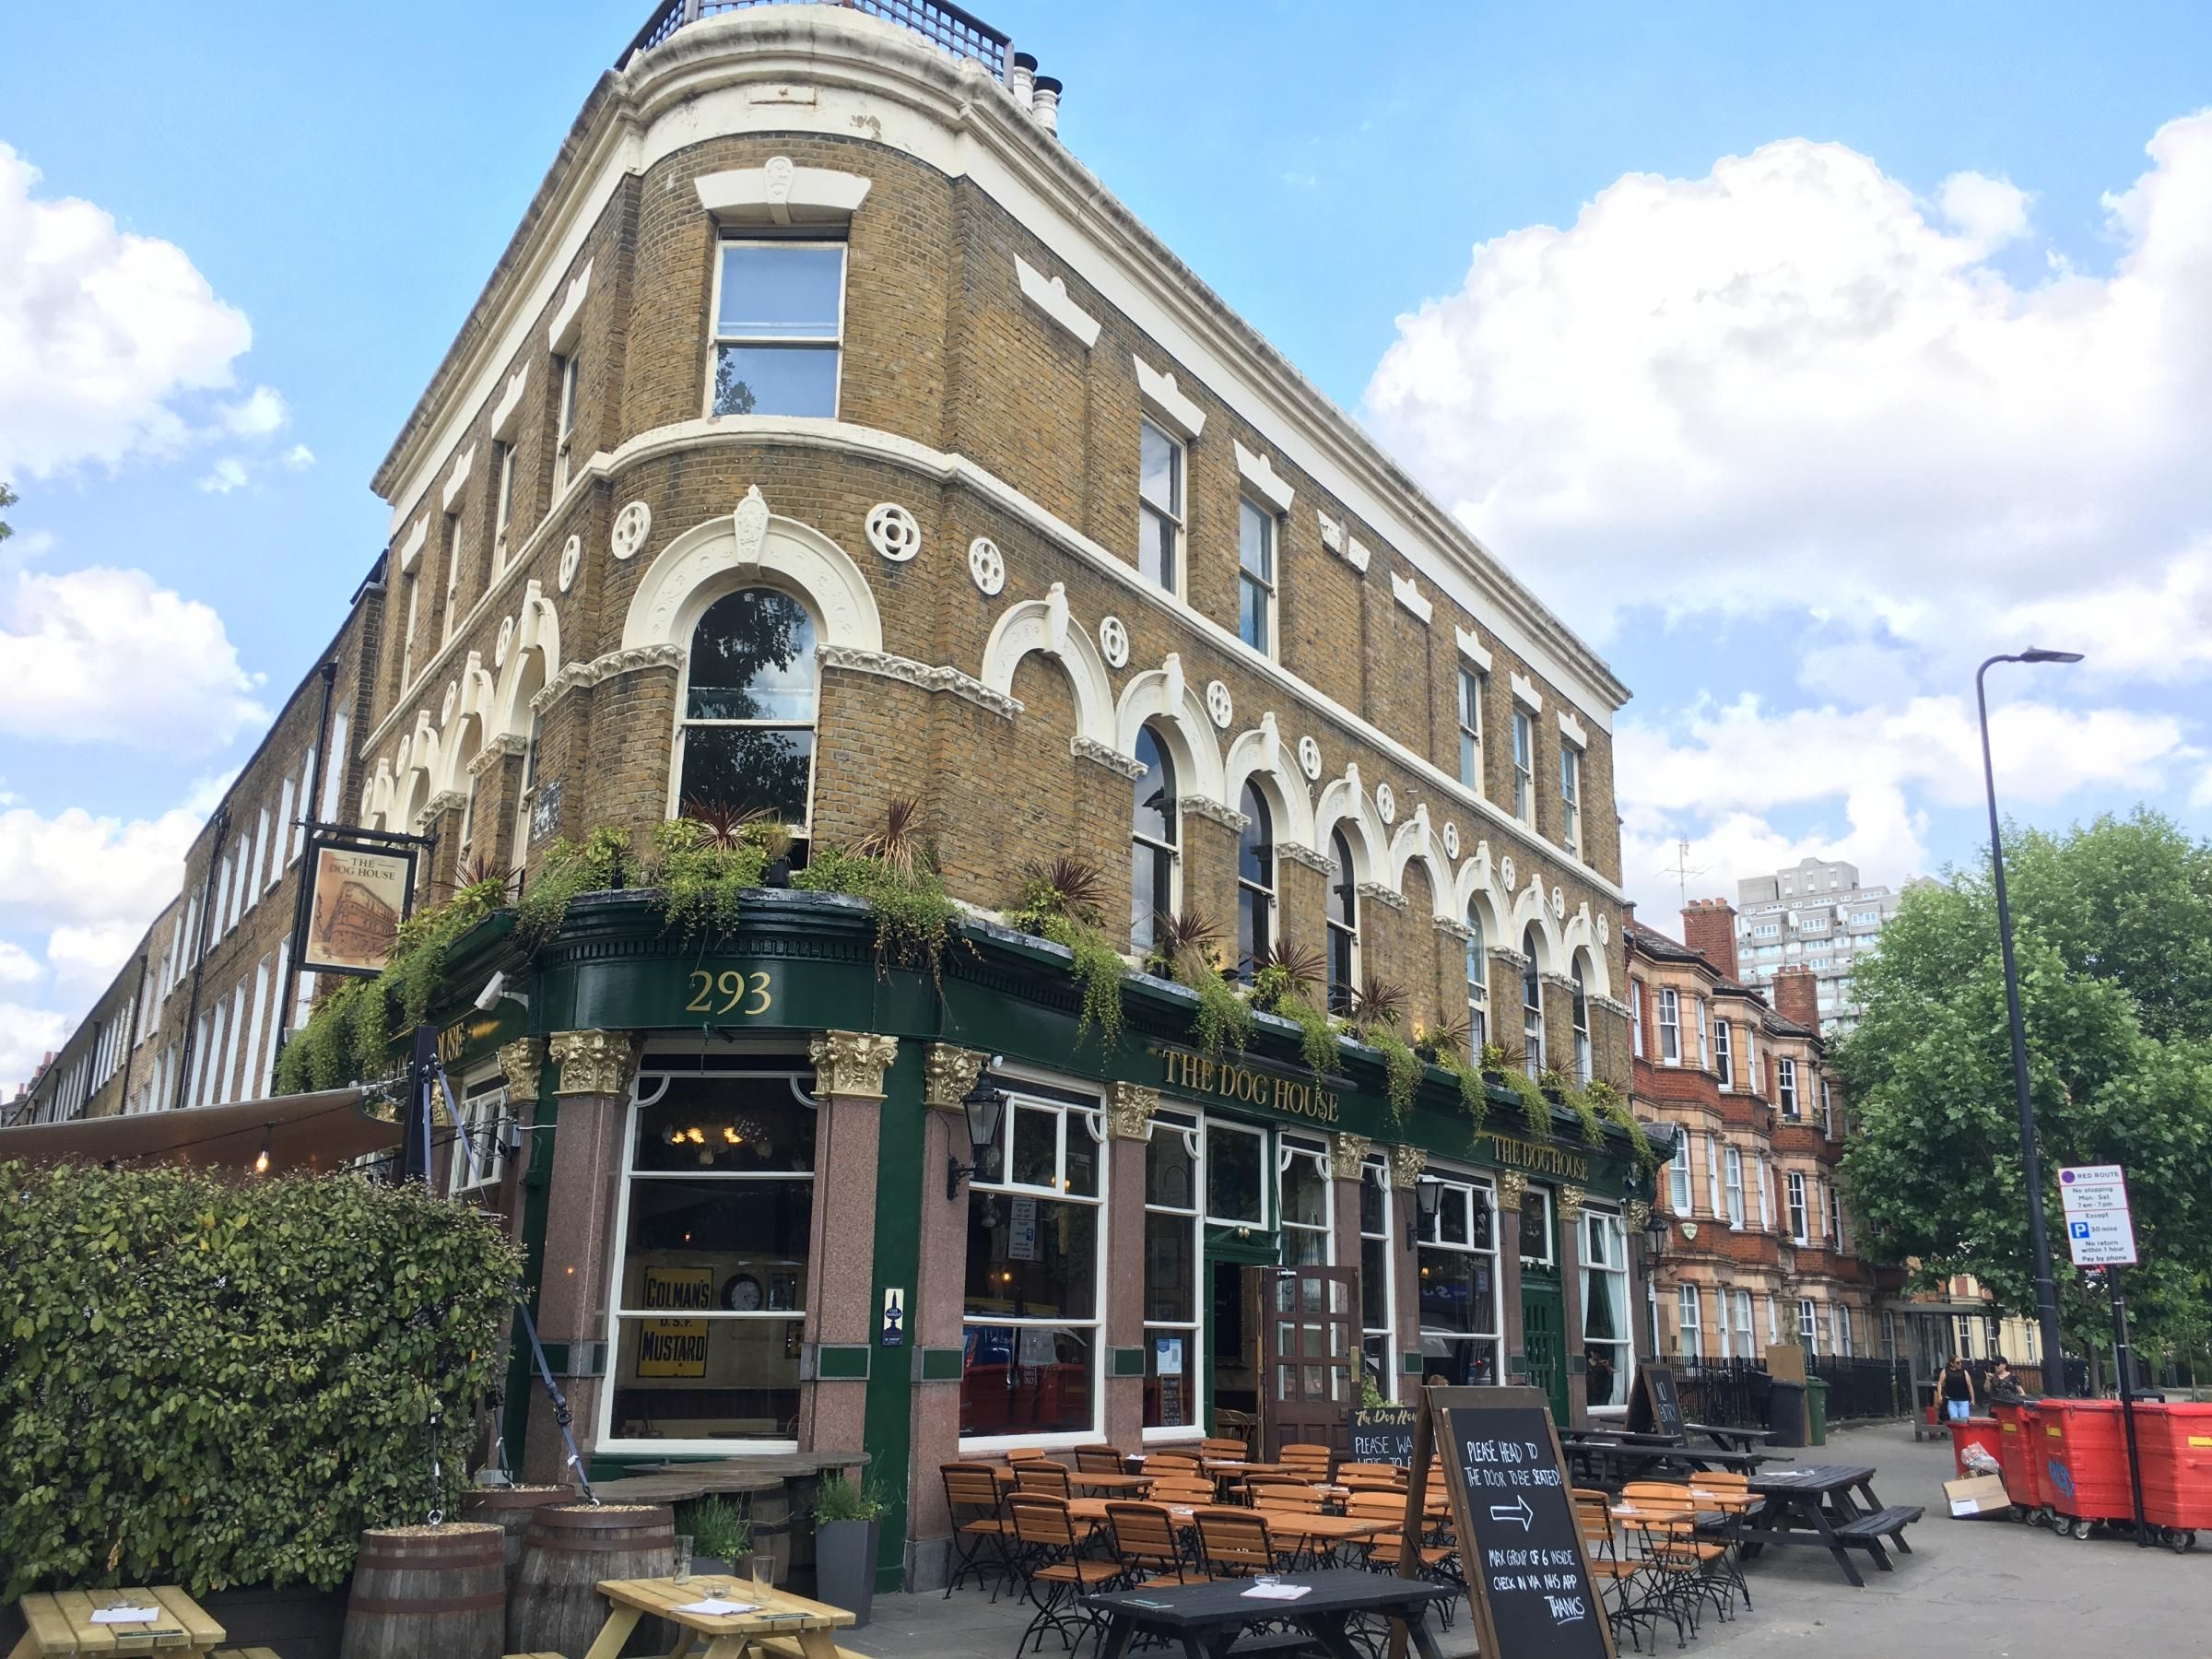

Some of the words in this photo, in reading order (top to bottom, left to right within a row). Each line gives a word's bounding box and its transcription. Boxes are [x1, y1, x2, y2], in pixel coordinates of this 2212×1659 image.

[351, 857, 375, 868] THE
[329, 865, 355, 875] DOG
[358, 868, 395, 880] HOUSE
[685, 971, 771, 1015] 293
[1163, 1049, 1213, 1092] THE
[1219, 1064, 1268, 1105] DOG
[1274, 1078, 1339, 1122] HOUSE
[1493, 1135, 1520, 1164] THE
[1523, 1143, 1548, 1171] DOG
[1552, 1151, 1588, 1181] HOUSE
[2074, 1224, 2086, 1237] P
[642, 1331, 705, 1361] MUSTARD
[1656, 1382, 1667, 1400] NO
[1355, 1410, 1371, 1426] The
[1373, 1410, 1394, 1424] Dog
[1397, 1410, 1416, 1424] Hou
[1355, 1436, 1389, 1454] PLEASE
[1396, 1435, 1413, 1453] WA
[1467, 1440, 1498, 1463] PLEASE
[1498, 1441, 1522, 1463] HEAD
[1525, 1442, 1538, 1460] TO
[1464, 1467, 1482, 1487] THE
[1483, 1469, 1507, 1487] DOOR
[1508, 1471, 1518, 1485] TO
[1518, 1471, 1531, 1486] BE
[1532, 1464, 1562, 1486] SEATED!
[1489, 1549, 1506, 1567] MAX
[1507, 1550, 1527, 1566] GROUP
[1530, 1550, 1539, 1565] OF
[1542, 1549, 1549, 1566] 6
[1550, 1550, 1575, 1565] INSIDE
[1493, 1576, 1516, 1591] CHECK
[1517, 1576, 1526, 1590] IN
[1527, 1575, 1541, 1590] VIA
[1544, 1574, 1561, 1590] NHS
[1563, 1574, 1577, 1590] APP
[1544, 1596, 1585, 1618] THANKS
